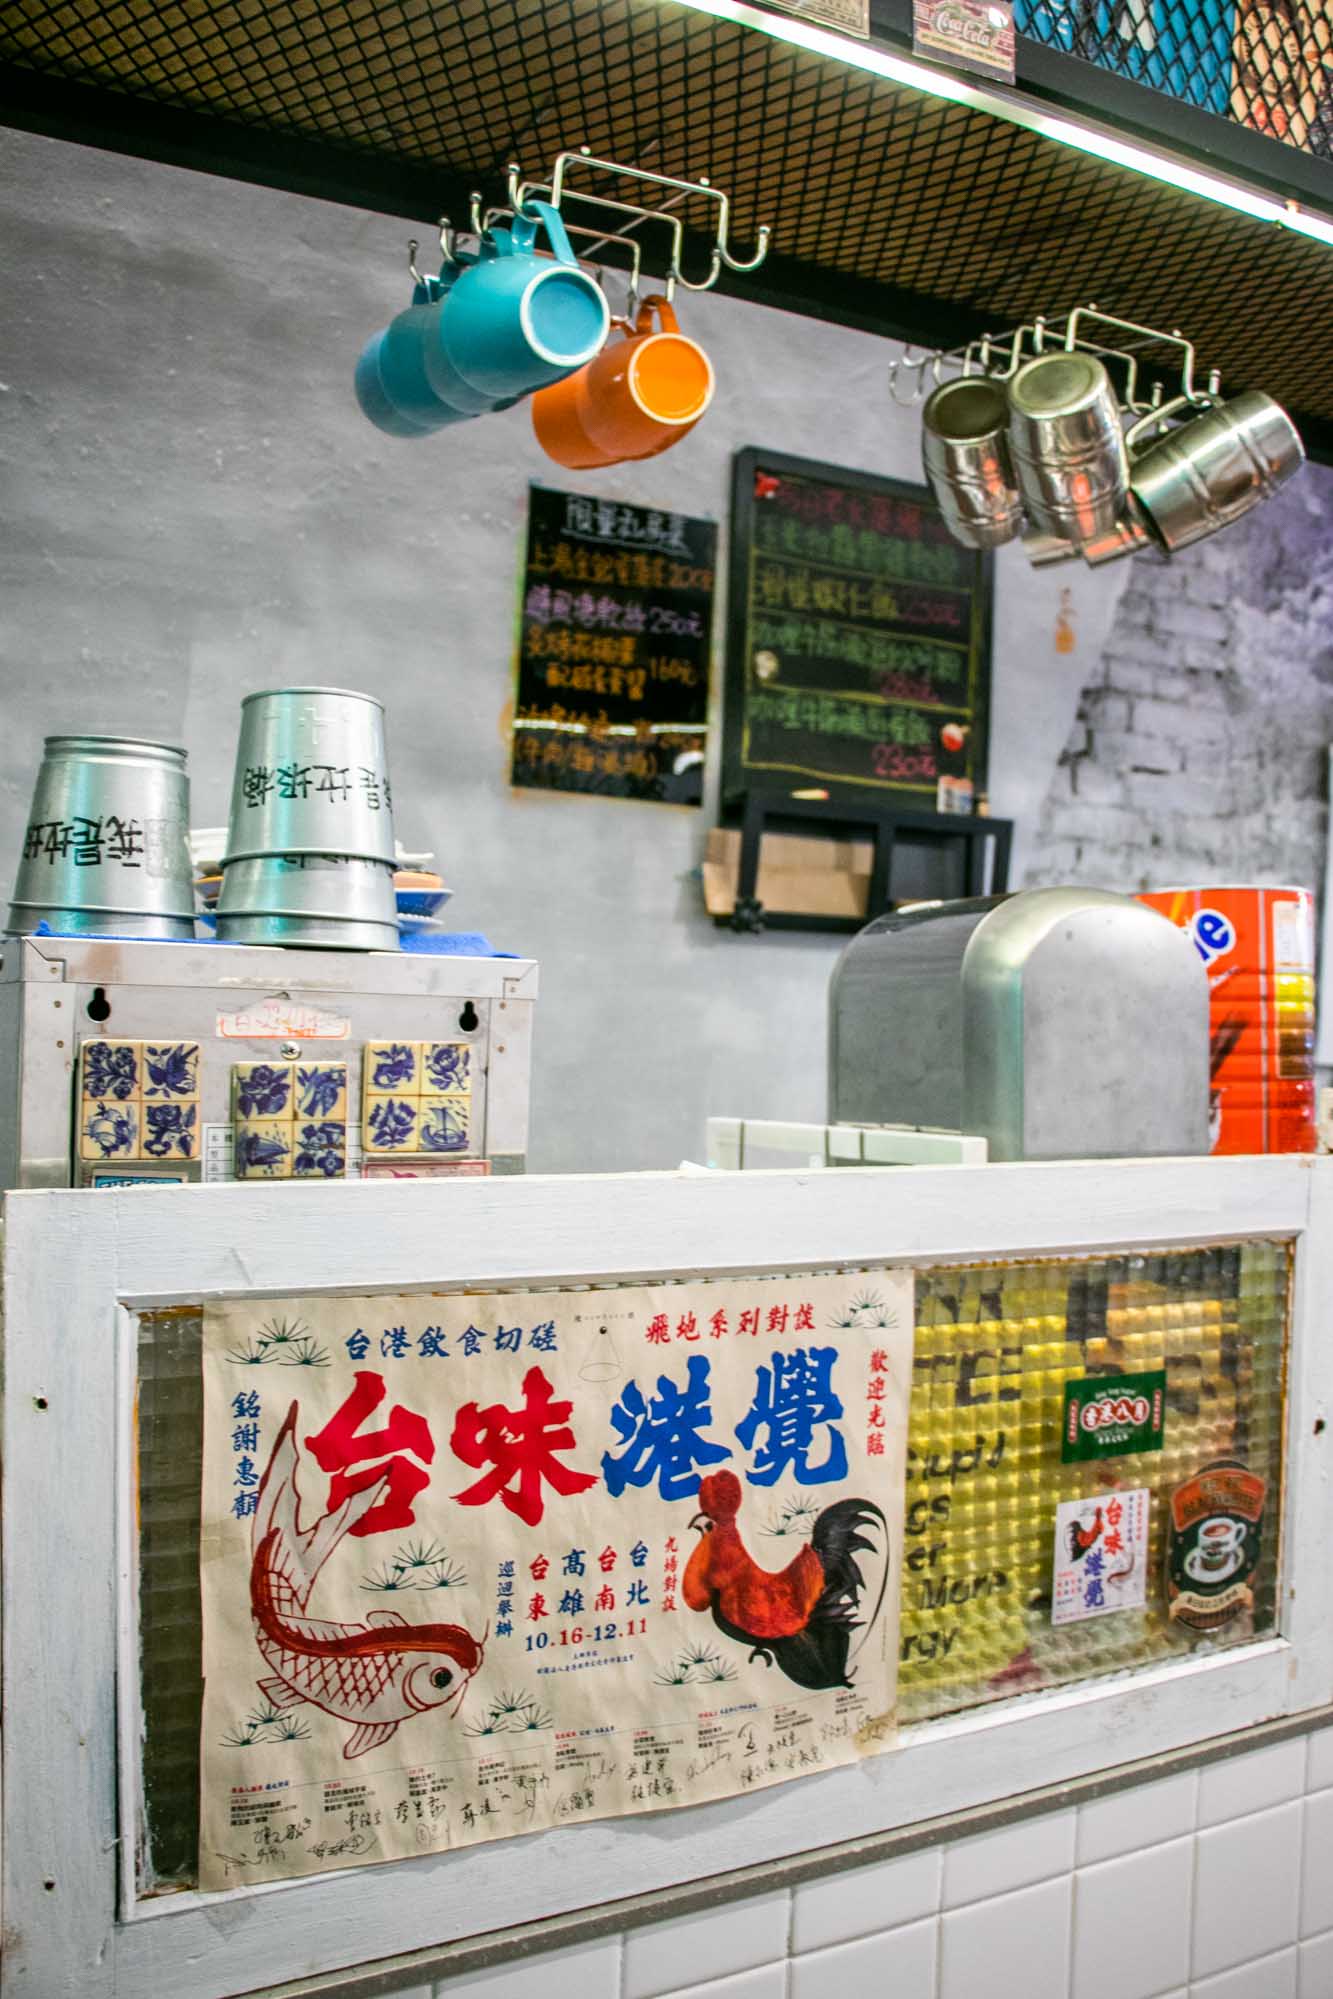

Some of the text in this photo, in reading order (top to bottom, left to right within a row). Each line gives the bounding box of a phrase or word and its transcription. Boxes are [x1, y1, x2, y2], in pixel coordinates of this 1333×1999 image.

[345, 1321, 557, 1361] 台港飲食切磋
[866, 1350, 889, 1457] 歡迎光臨
[525, 1617, 648, 1652] 10.16-12.11
